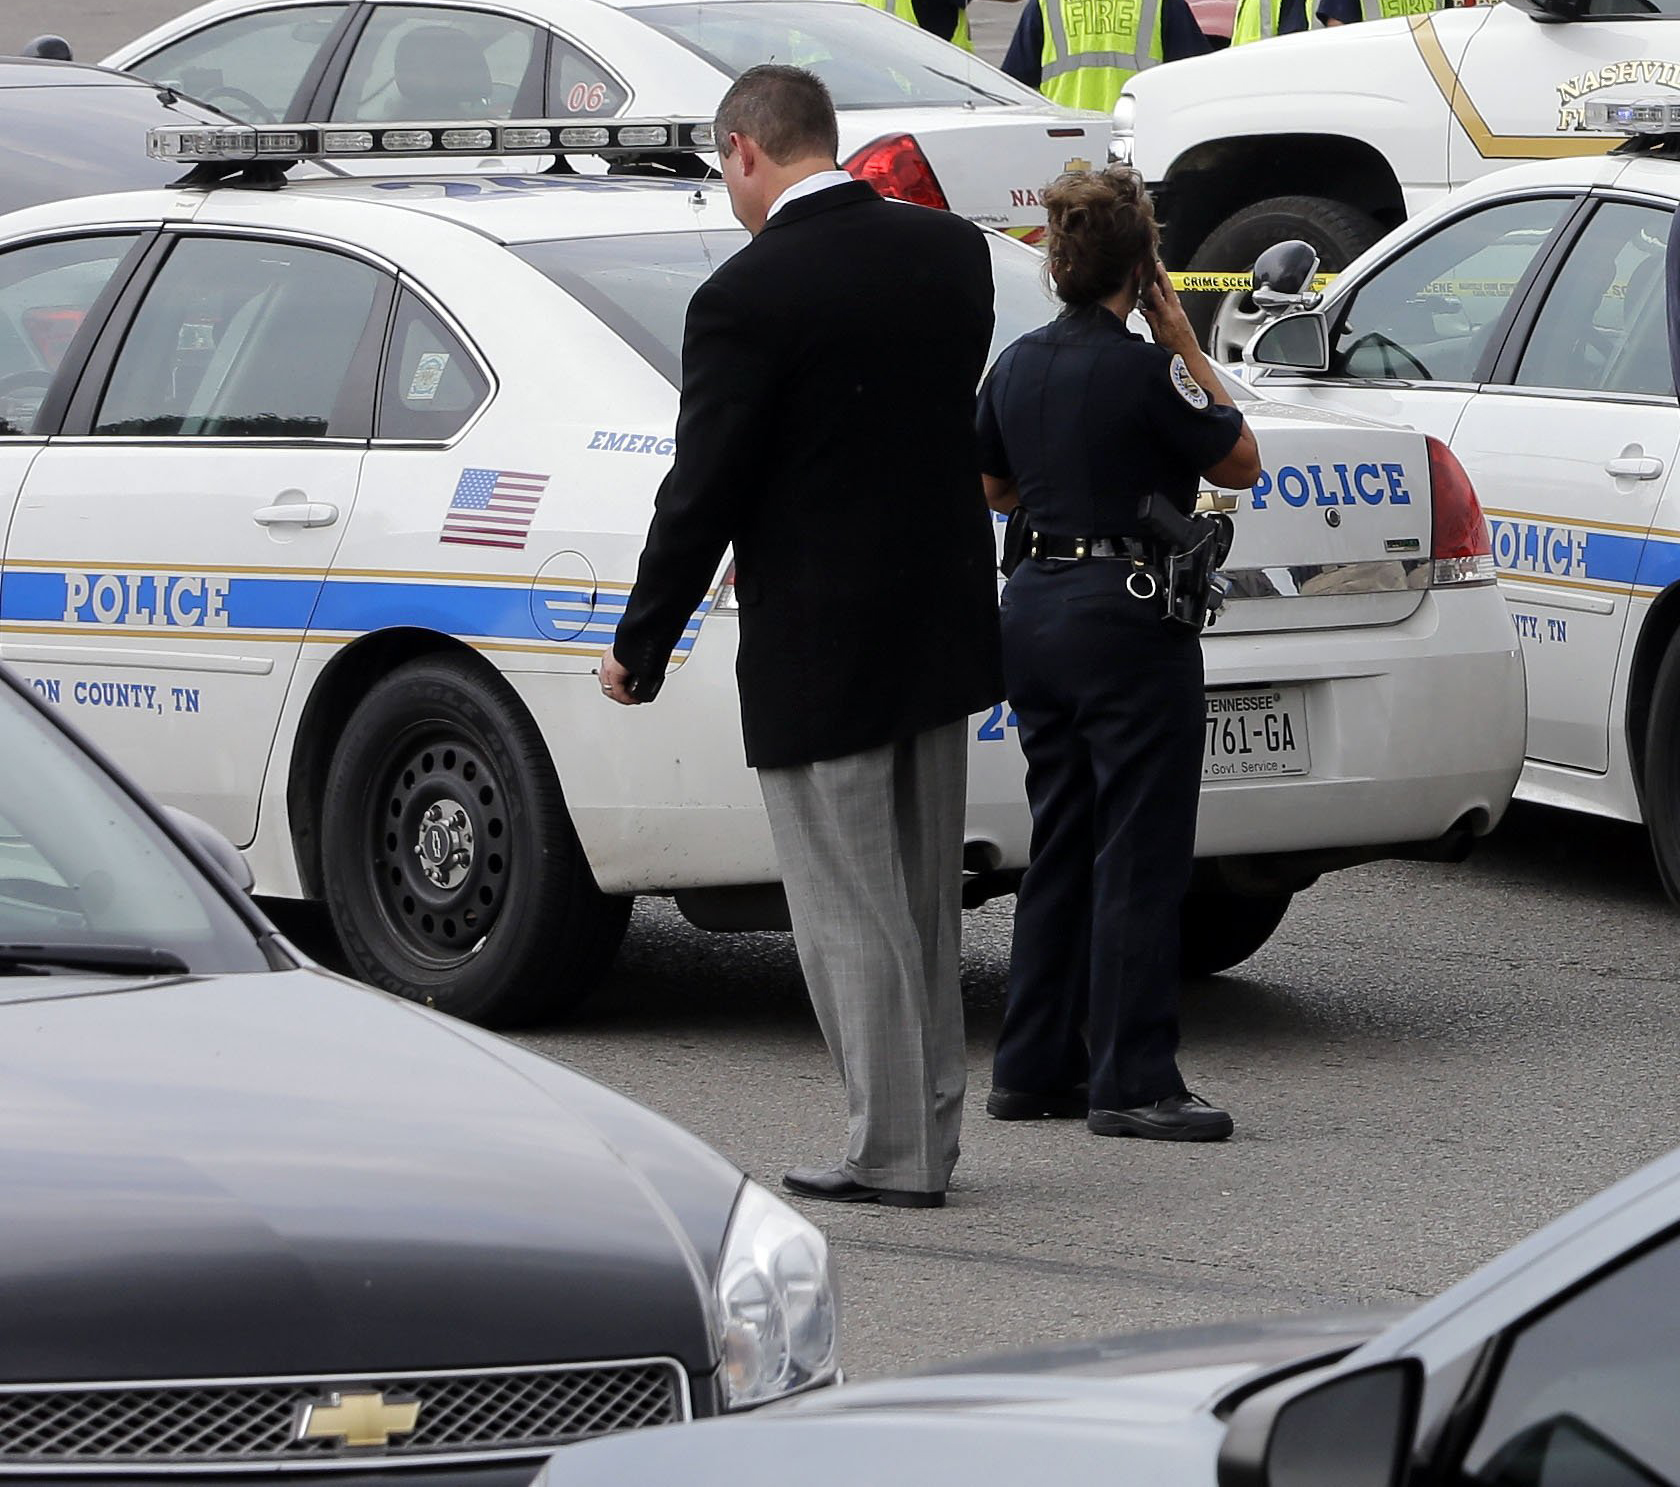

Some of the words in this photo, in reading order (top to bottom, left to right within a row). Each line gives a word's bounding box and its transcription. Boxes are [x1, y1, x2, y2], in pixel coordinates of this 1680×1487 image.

[1065, 0, 1136, 38] FIRE
[567, 82, 607, 112] 06
[1183, 276, 1218, 287] CRIME
[1222, 277, 1253, 287] SCEN
[586, 430, 677, 456] EMERG
[1251, 462, 1411, 509] POLICE
[1488, 520, 1588, 579] OLICE
[64, 571, 231, 628] POLICE
[1547, 618, 1569, 643] TN
[74, 680, 163, 715] COUNTY,
[171, 686, 201, 713] TN
[1206, 695, 1274, 713] TENNESSEE
[1205, 712, 1297, 756] 761-GA
[1211, 762, 1238, 775] Govt.
[1241, 760, 1279, 773] Service
